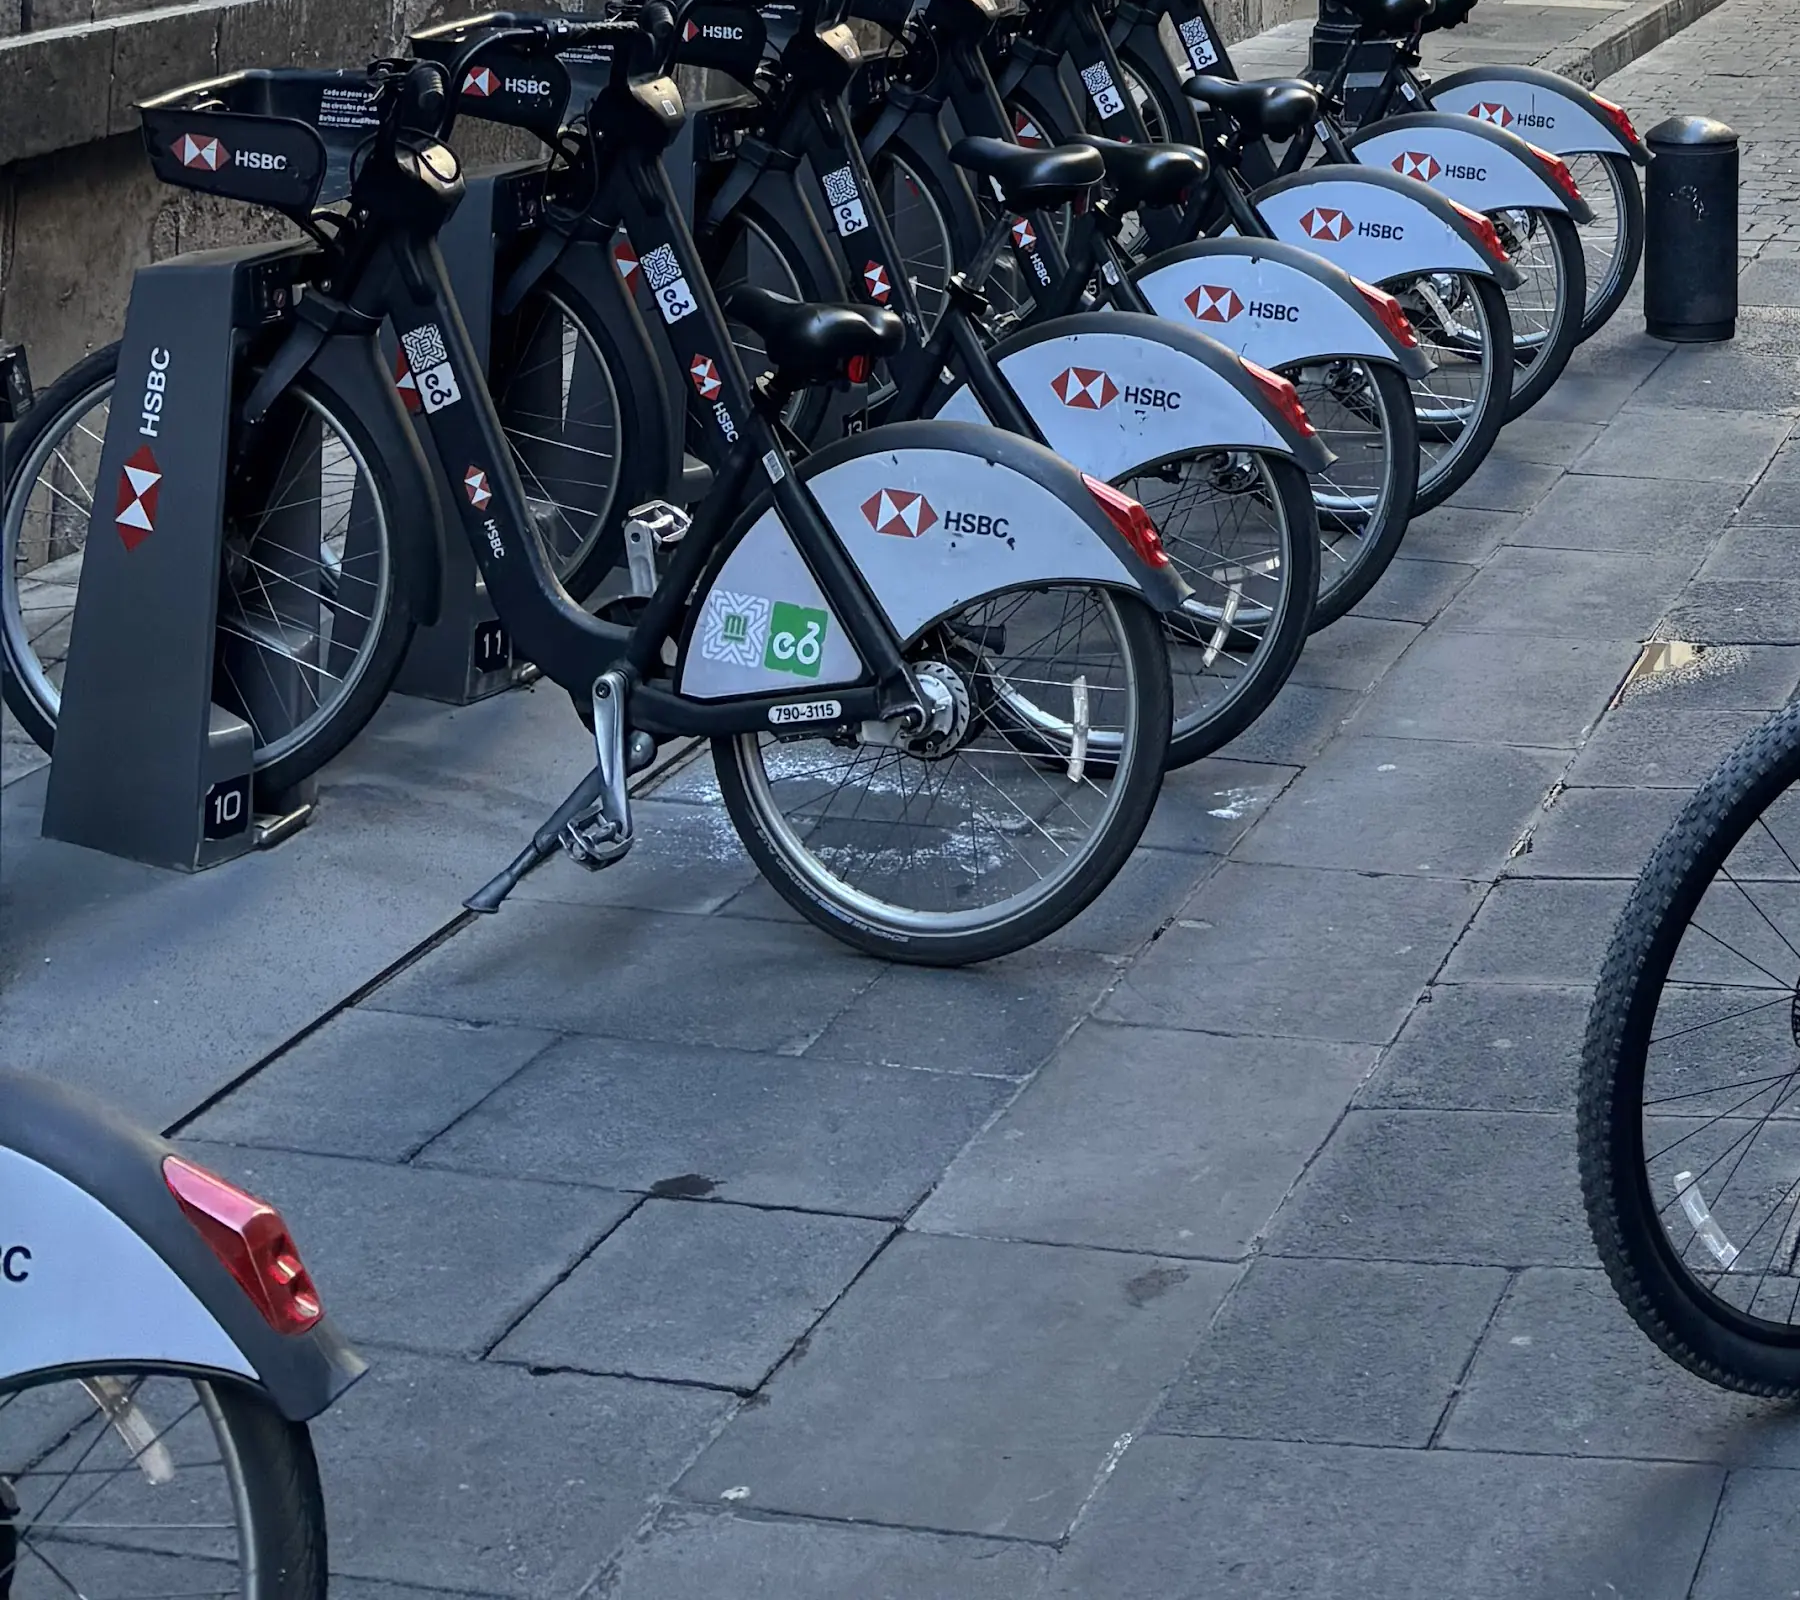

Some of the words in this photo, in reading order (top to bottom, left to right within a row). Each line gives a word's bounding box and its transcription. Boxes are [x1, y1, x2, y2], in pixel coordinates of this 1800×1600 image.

[703, 24, 743, 40] HSBC
[505, 77, 551, 96] HSBC
[1517, 113, 1555, 129] HSBC
[235, 149, 287, 171] HSBC
[1445, 164, 1487, 182] HSBC
[1358, 222, 1404, 241] HSBC
[1029, 252, 1051, 287] HSBC
[1249, 301, 1300, 322] HSBC
[139, 347, 170, 438] HSBC
[1124, 385, 1182, 410] HSBC
[713, 401, 739, 443] HSBC
[944, 510, 1010, 539] HSBC
[484, 518, 504, 559] HSBC
[483, 629, 502, 658] 11
[775, 703, 834, 722] 790-3115
[214, 790, 242, 825] 10
